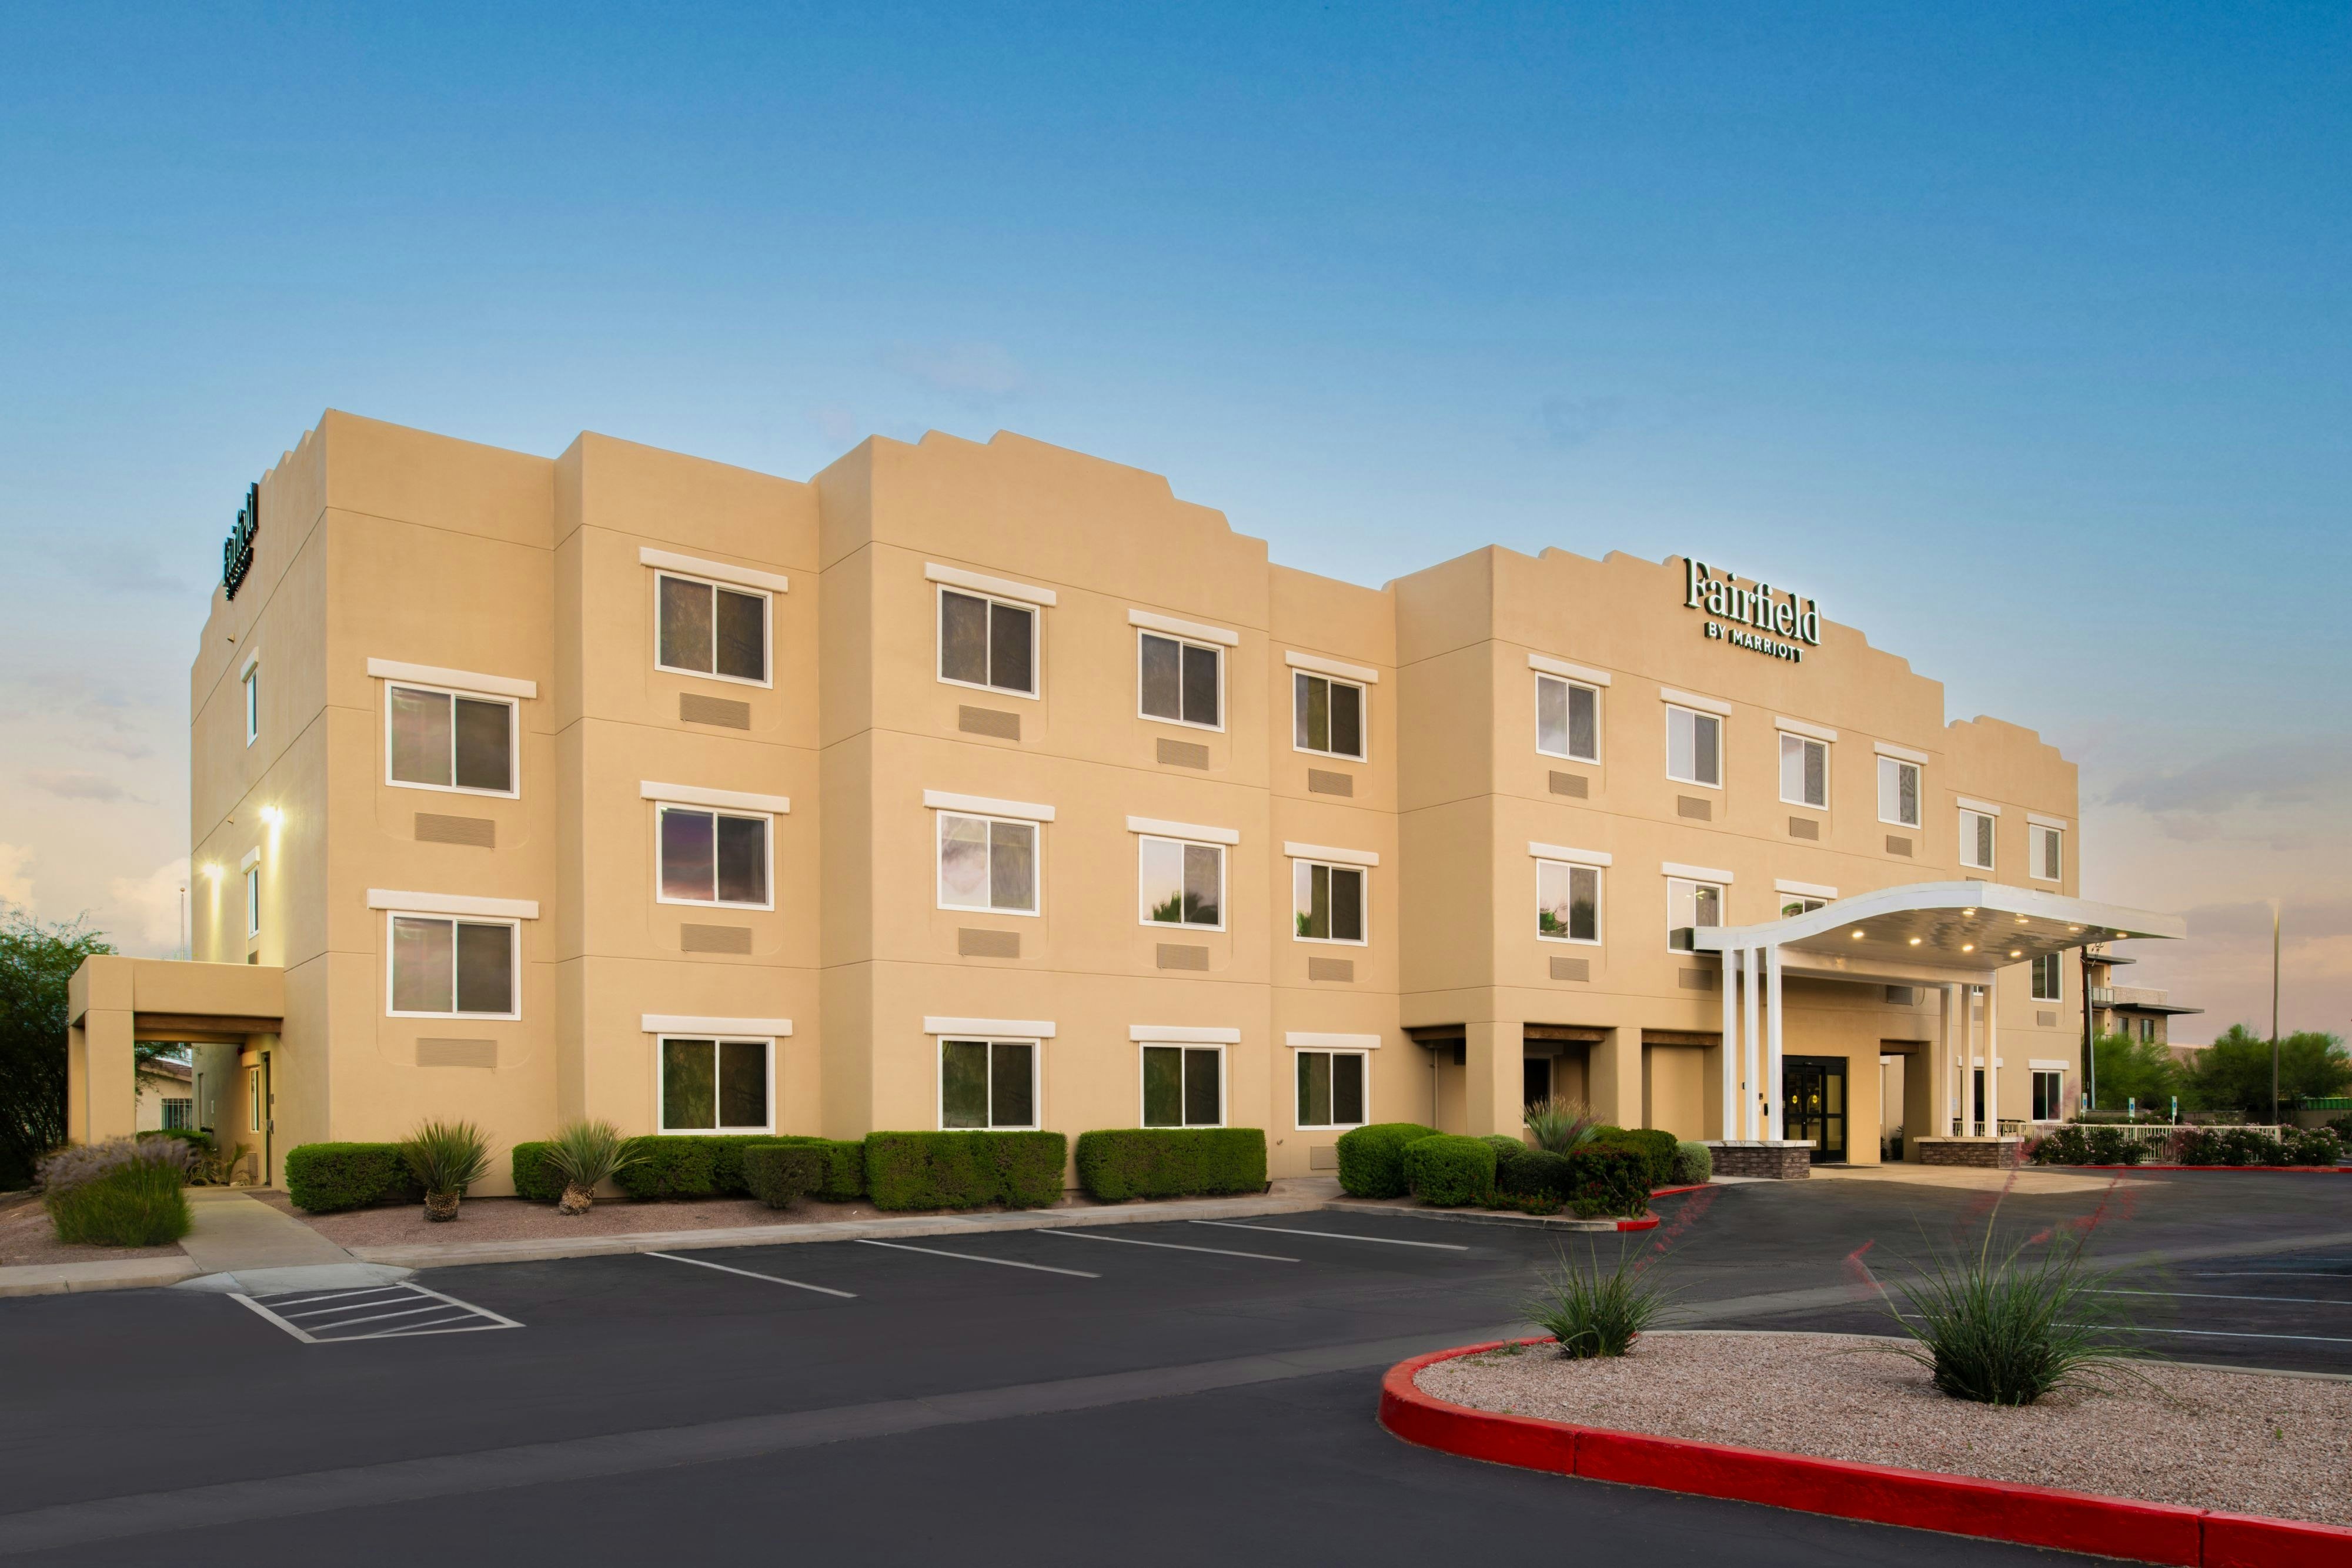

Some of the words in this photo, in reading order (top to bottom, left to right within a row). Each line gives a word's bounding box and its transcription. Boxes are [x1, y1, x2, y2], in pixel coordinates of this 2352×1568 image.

[1683, 557, 1822, 646] Fairfield
[1705, 621, 1726, 640] BY
[1729, 628, 1804, 663] MARRIOTT
